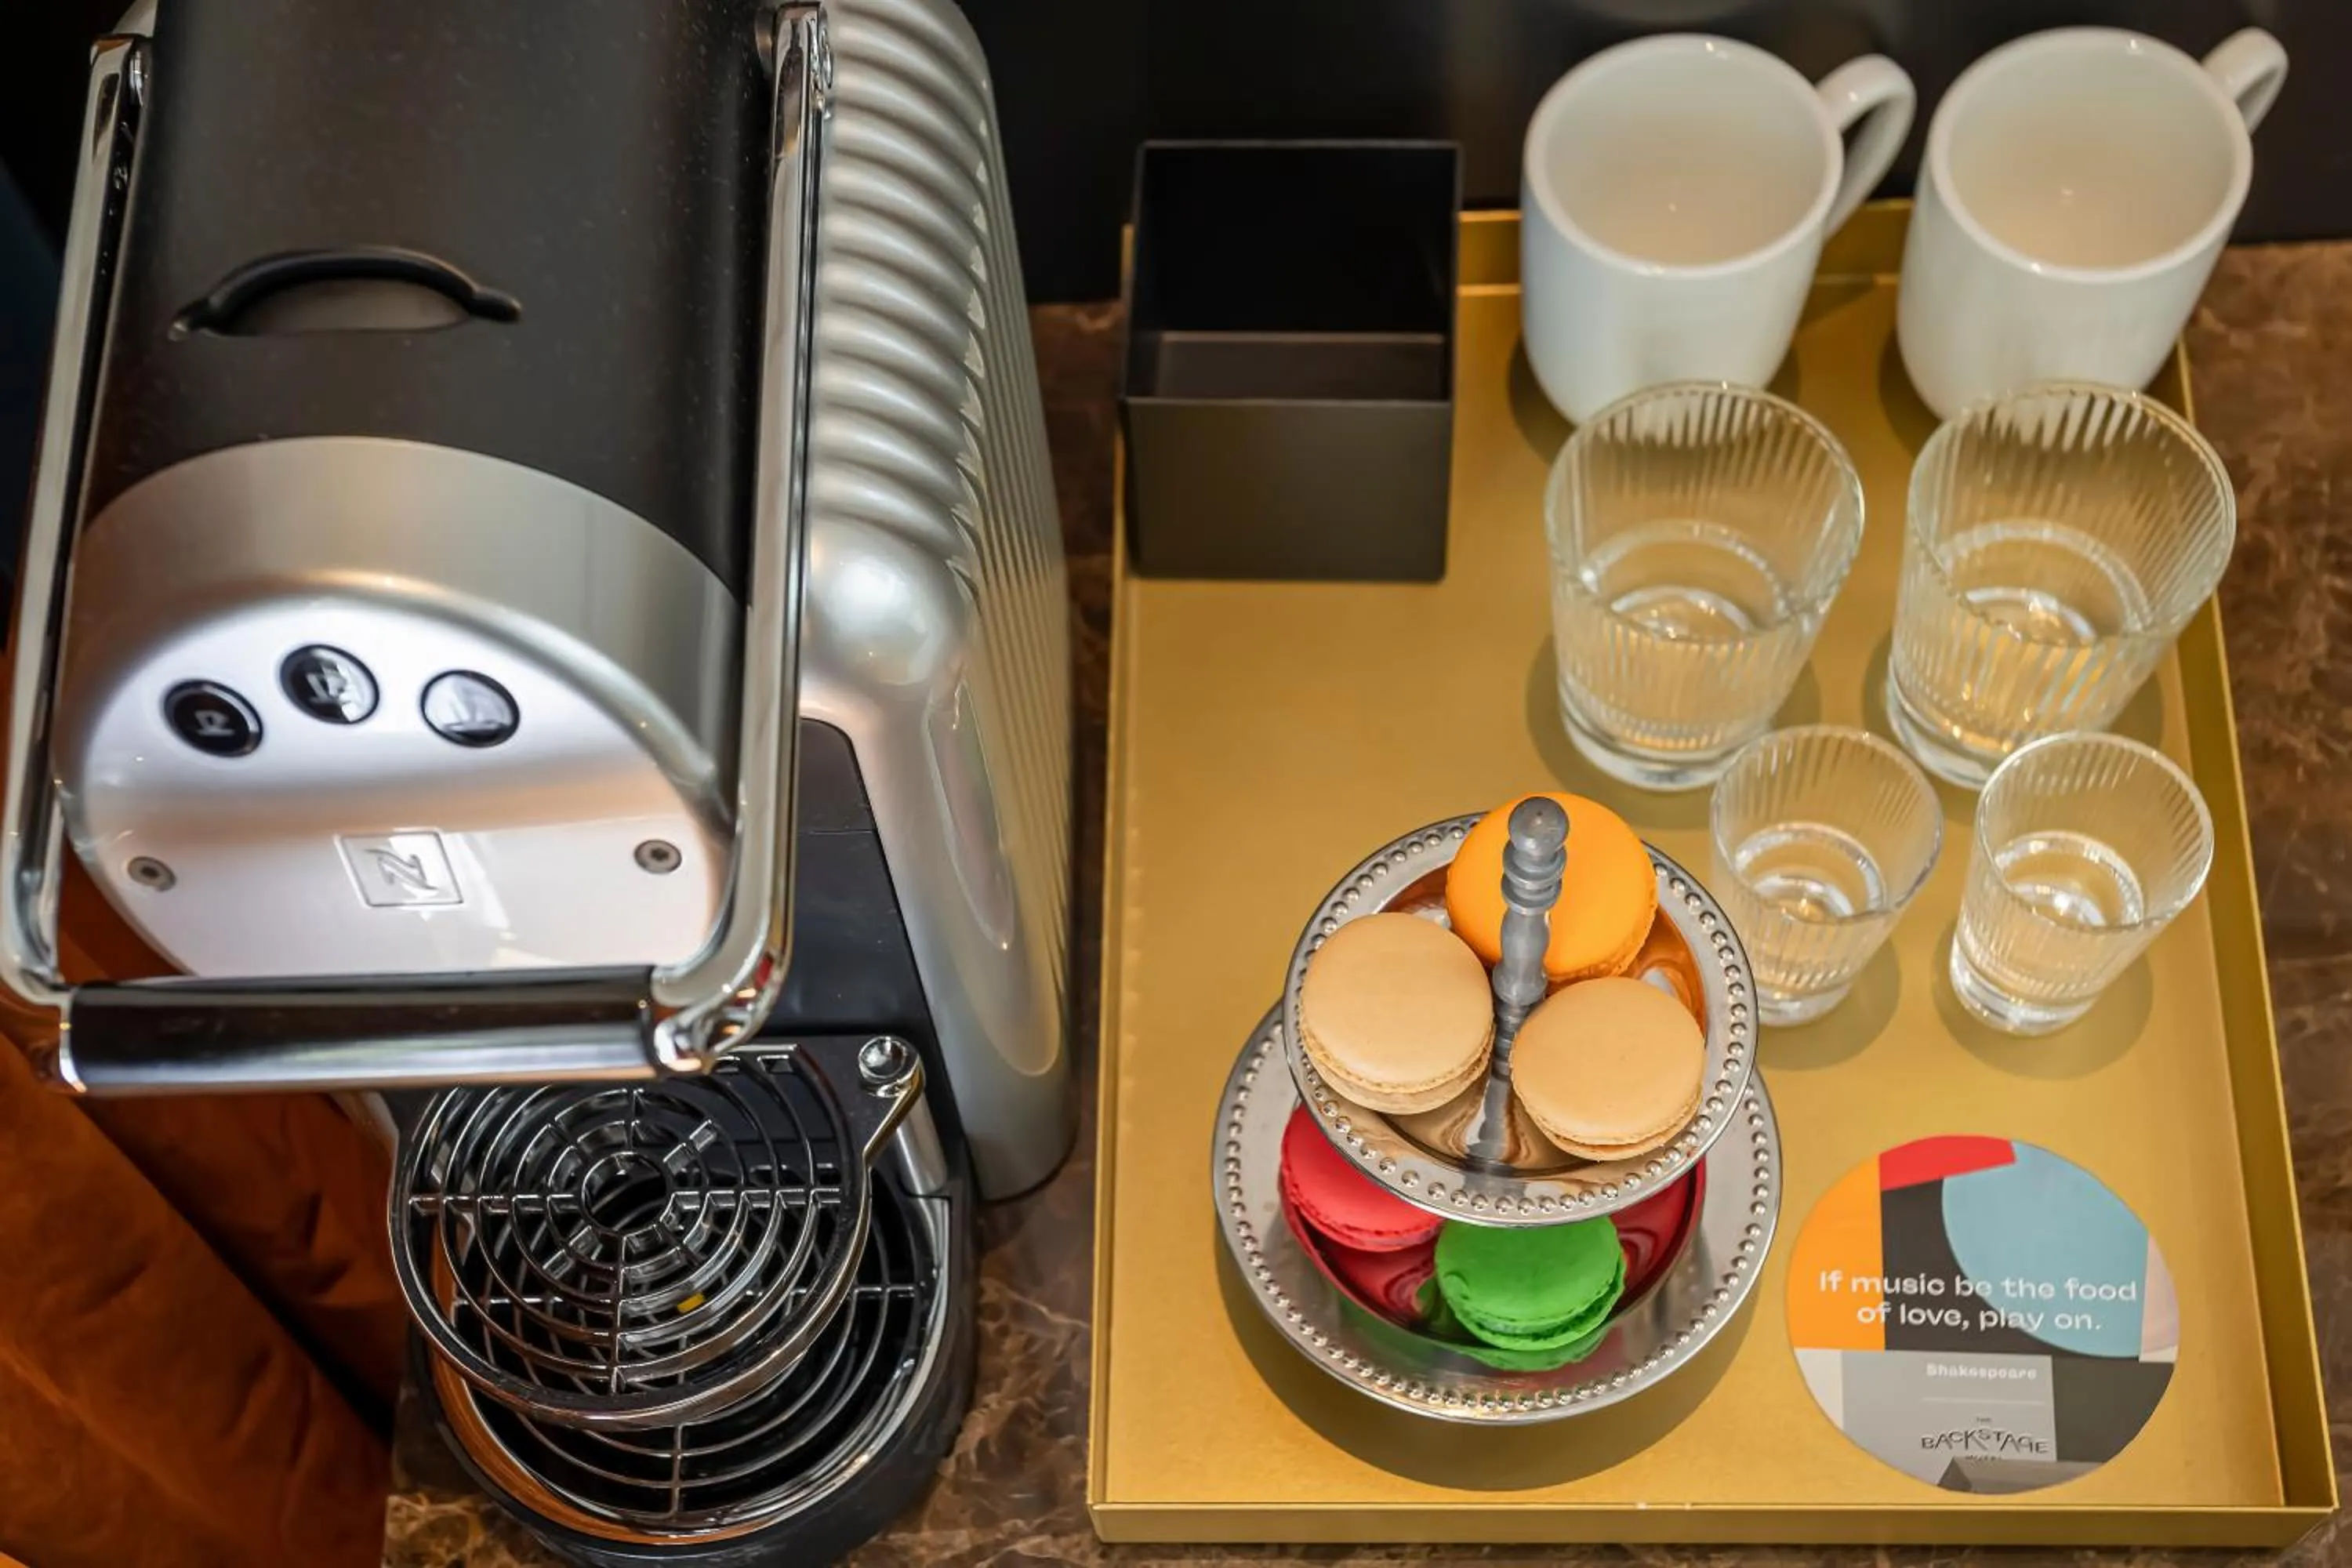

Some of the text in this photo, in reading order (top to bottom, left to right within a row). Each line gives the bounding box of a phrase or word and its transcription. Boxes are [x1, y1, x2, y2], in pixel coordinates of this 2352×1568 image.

[1820, 1270, 2136, 1301] If music be the food
[1857, 1301, 2102, 1332] of love, play on.
[1926, 1362, 2037, 1380] Shakespeare
[1921, 1428, 2049, 1454] BACKSTAGE
